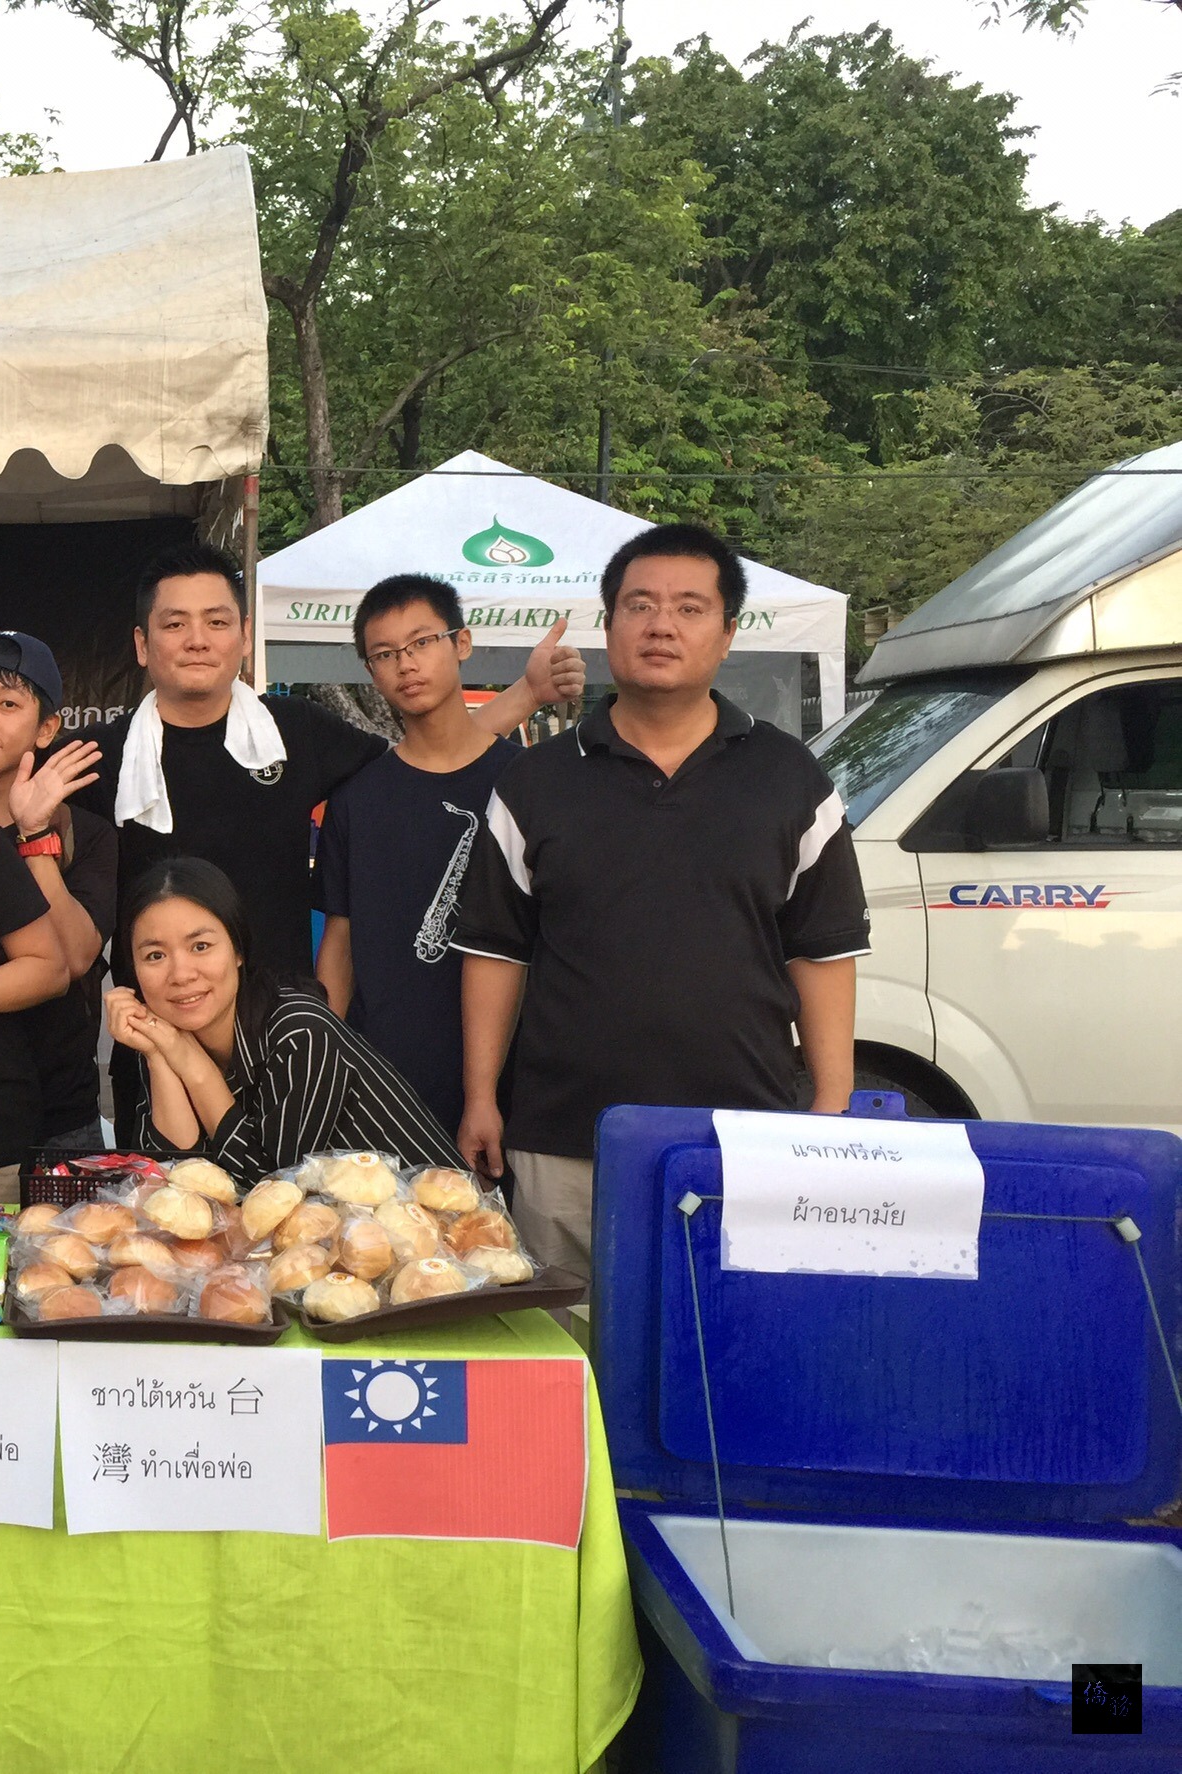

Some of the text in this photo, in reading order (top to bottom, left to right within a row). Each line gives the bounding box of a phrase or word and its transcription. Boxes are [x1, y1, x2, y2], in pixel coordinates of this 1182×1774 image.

[948, 884, 1106, 907] CARRY
[791, 1143, 903, 1163] แจกฟรีค่ะ
[793, 1196, 906, 1227] ผ้าอนามัย
[91, 1377, 264, 1415] ชาวไต้หวัน 台
[92, 1441, 252, 1483] 灣 ทำเพื่อพ่อ
